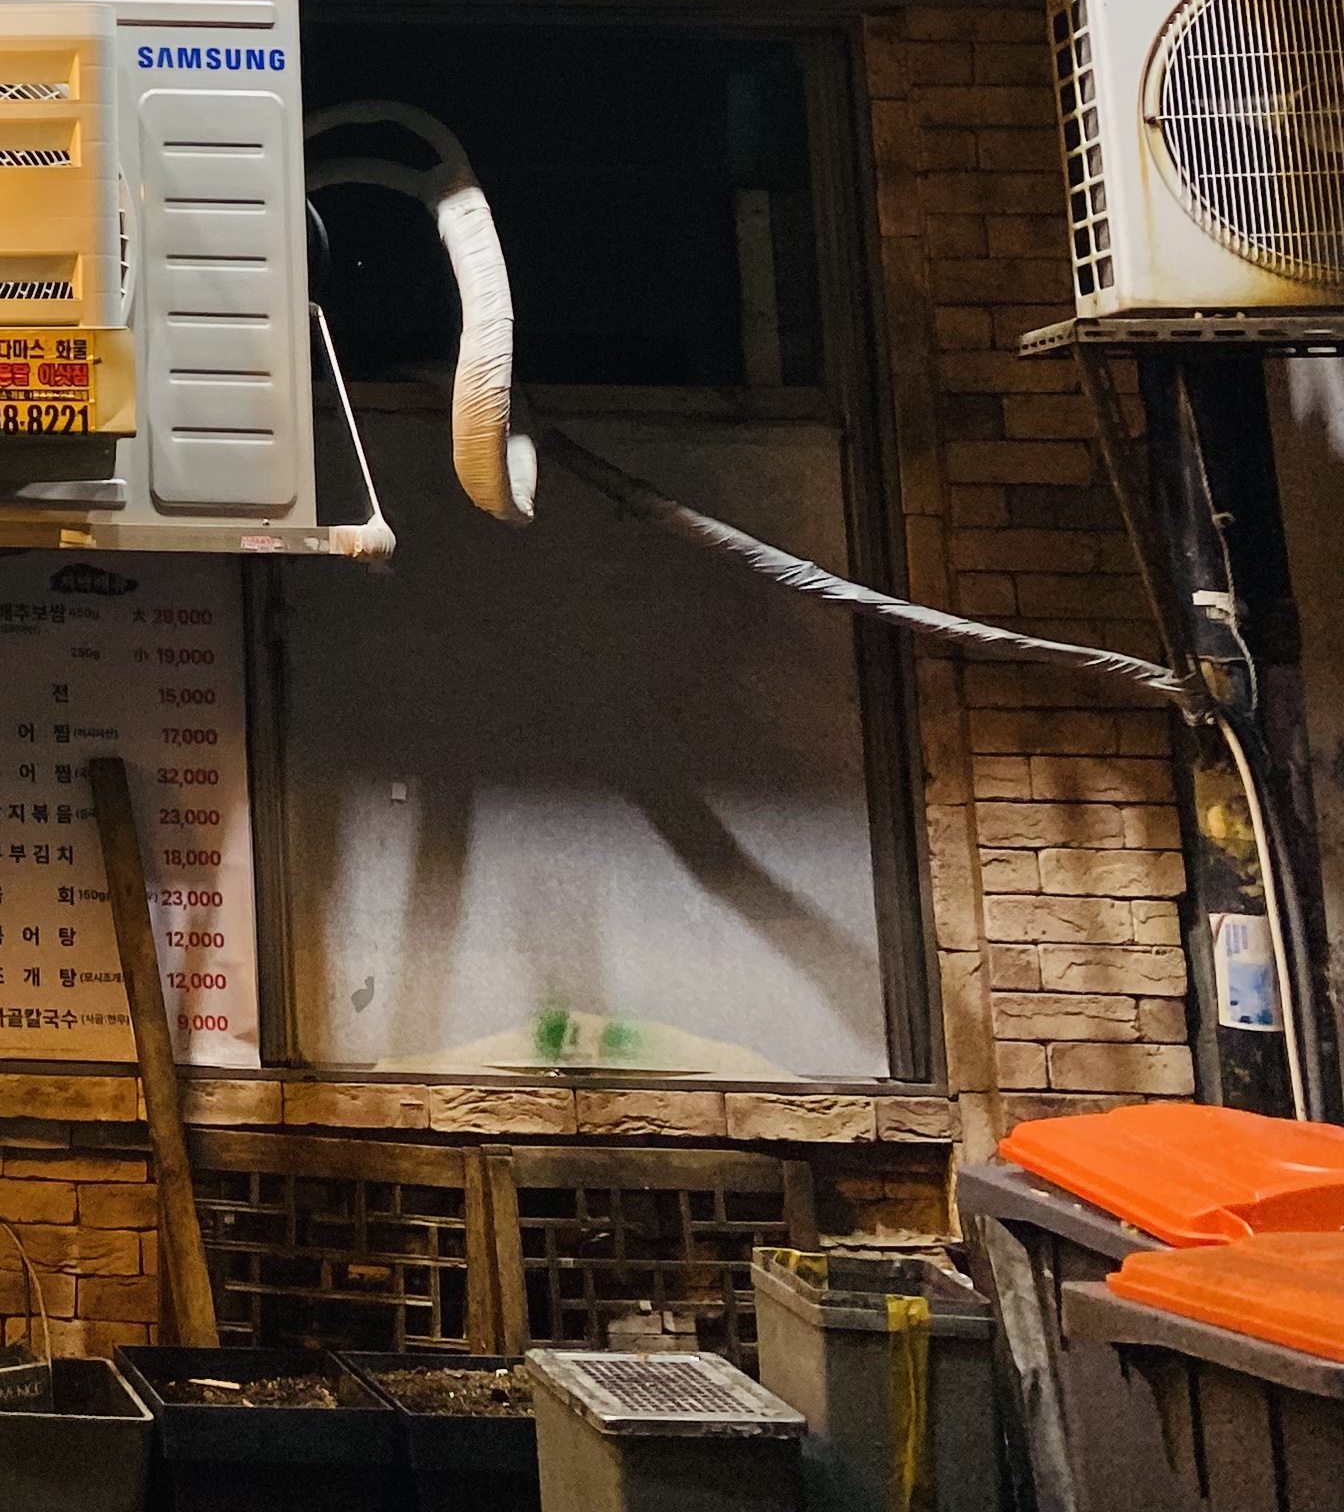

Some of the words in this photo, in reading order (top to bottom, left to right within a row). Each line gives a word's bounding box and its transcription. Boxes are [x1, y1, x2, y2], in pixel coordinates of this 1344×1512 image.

[136, 45, 287, 72] SAMSUNG
[55, 338, 88, 360] 화물
[38, 362, 89, 387] 이삿짐
[161, 727, 218, 746] 17,000
[156, 767, 219, 787] 32,000
[159, 808, 221, 829] 23,000
[163, 849, 222, 868] 18,000
[161, 890, 223, 910] 23,000
[165, 931, 226, 951] 12,000
[166, 973, 227, 993] 12,000
[177, 1014, 229, 1033] 9,000
